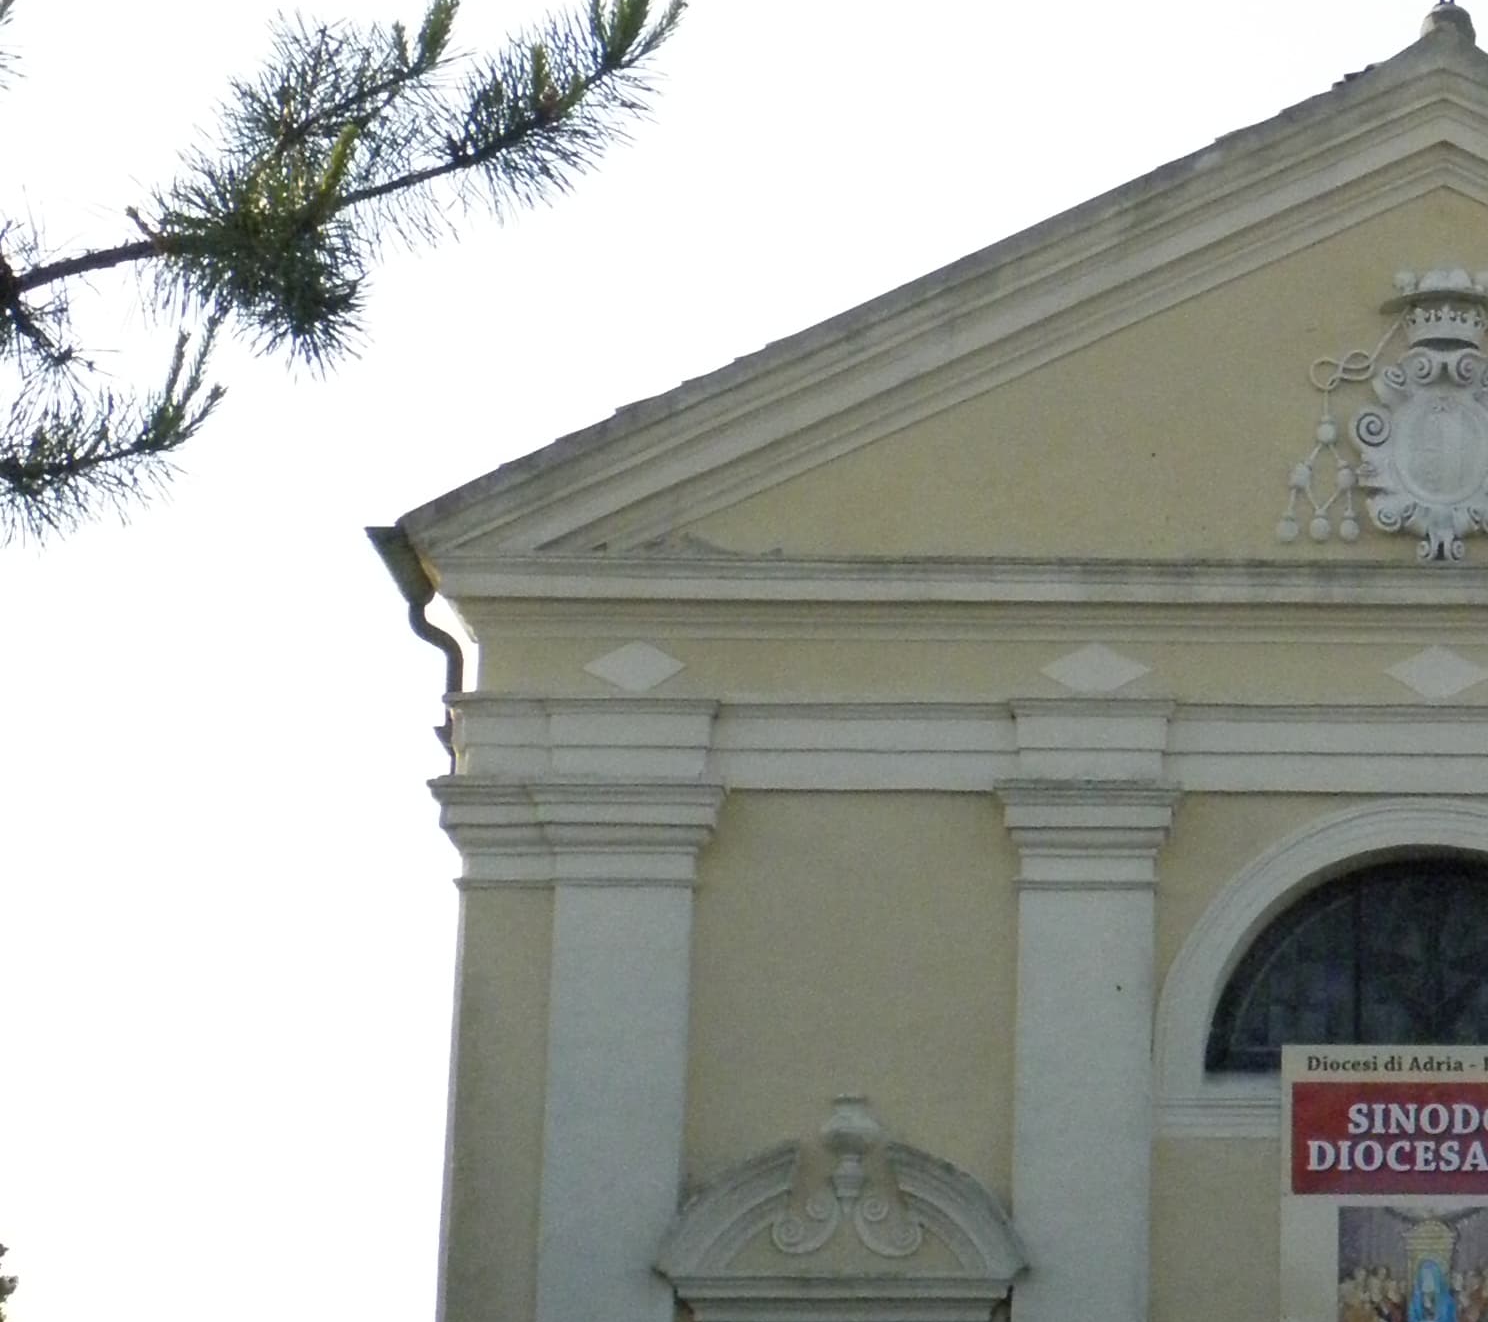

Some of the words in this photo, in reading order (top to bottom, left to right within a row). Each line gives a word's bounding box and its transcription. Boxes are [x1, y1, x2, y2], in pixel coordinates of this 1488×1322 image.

[1307, 1056, 1378, 1072] Diocesi
[1384, 1056, 1402, 1072] di
[1409, 1056, 1464, 1072] Adria
